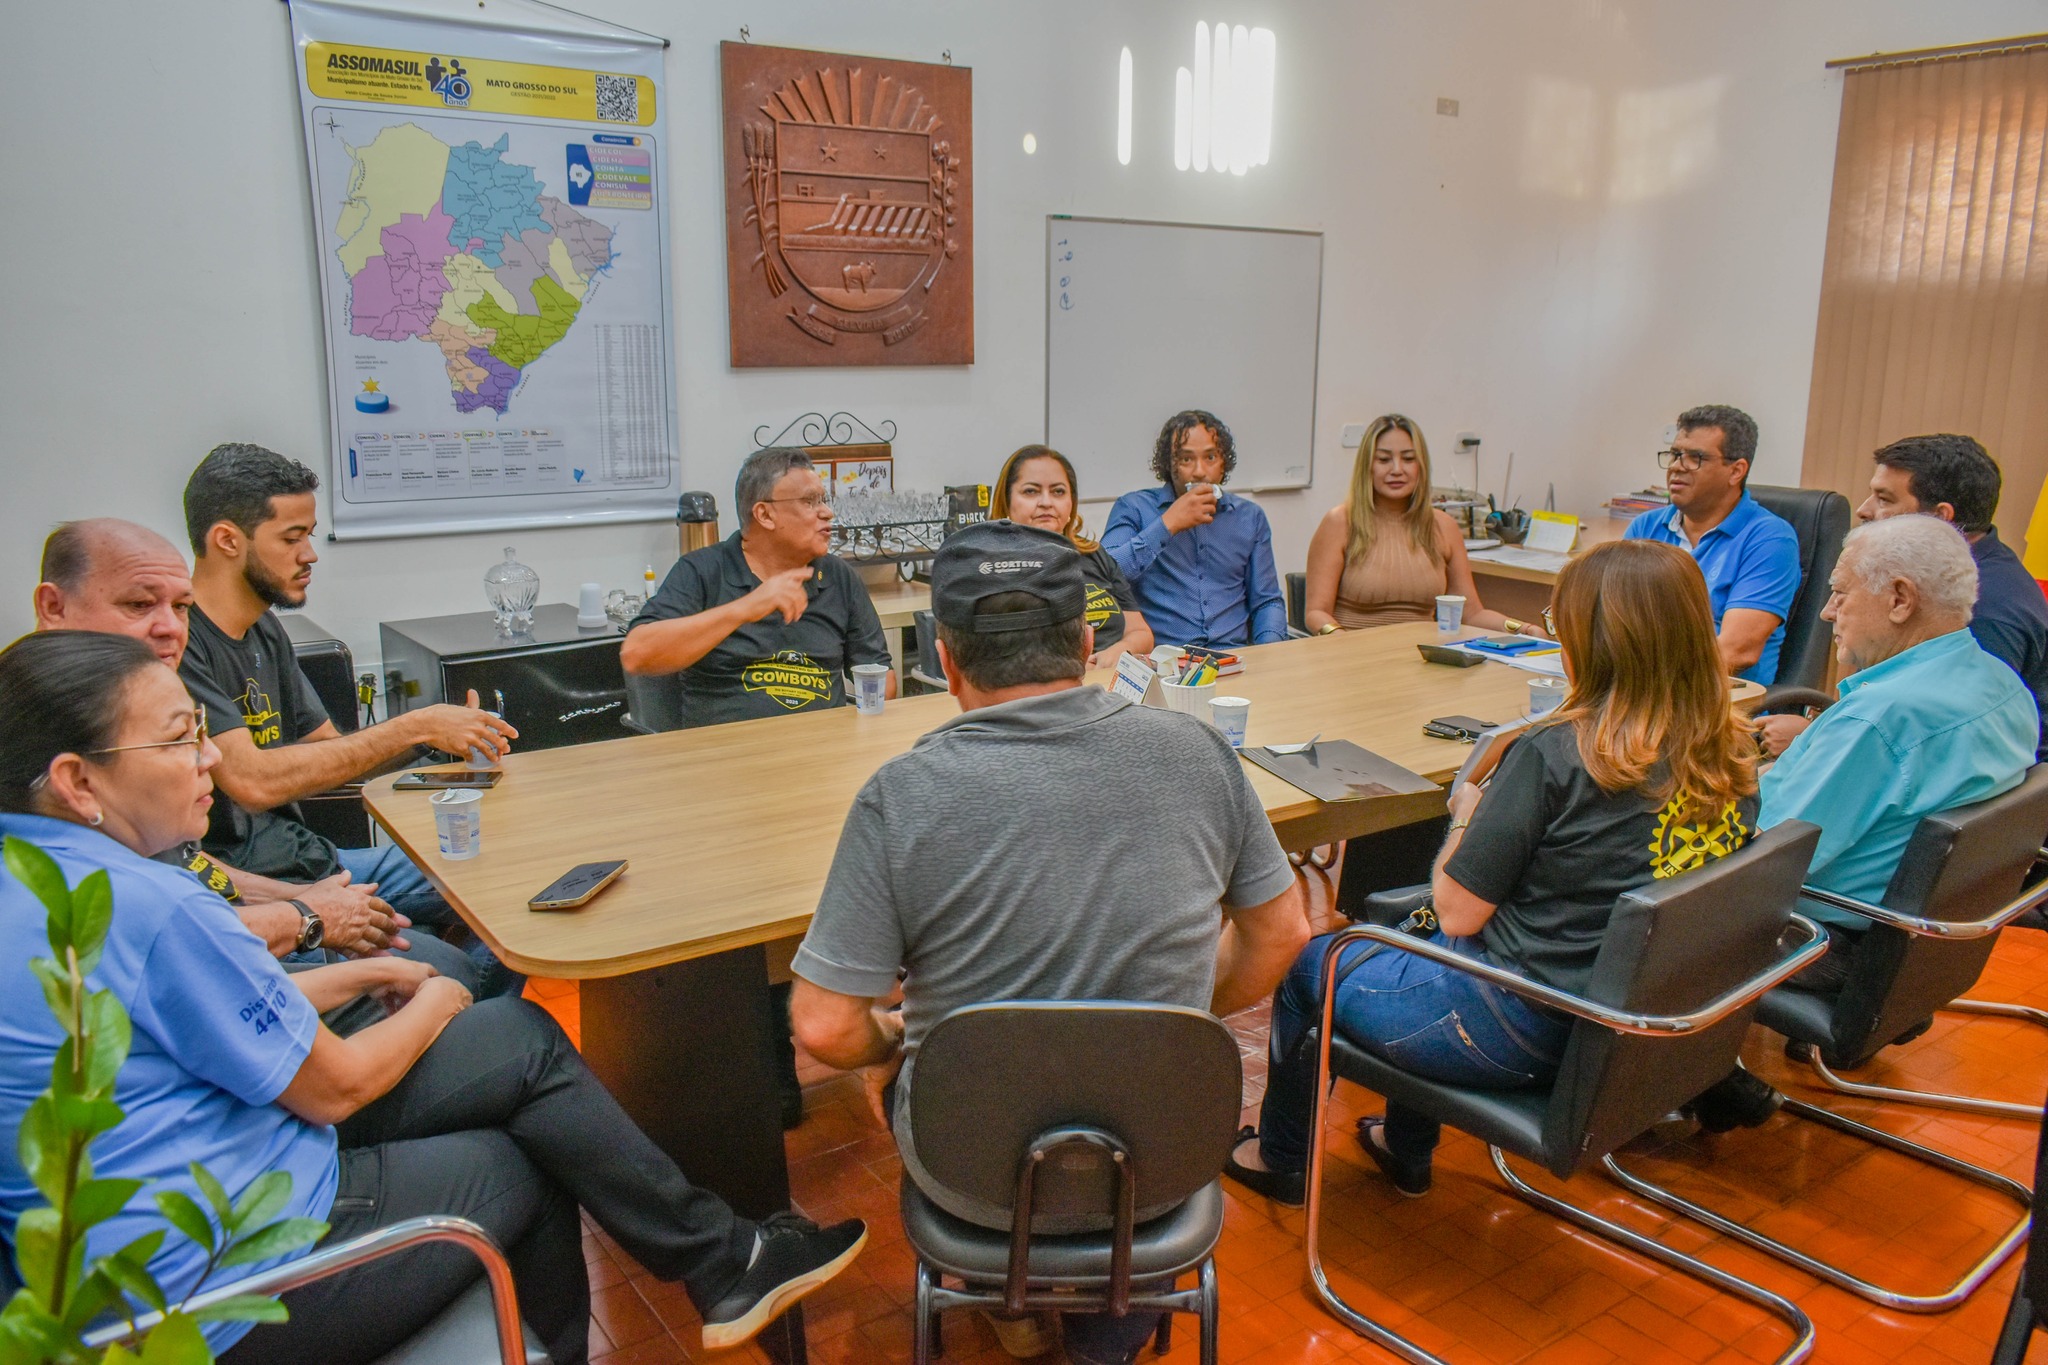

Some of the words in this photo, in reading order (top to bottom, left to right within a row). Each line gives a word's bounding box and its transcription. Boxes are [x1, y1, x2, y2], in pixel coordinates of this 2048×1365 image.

[327, 53, 422, 77] ASSOMASUL
[327, 76, 367, 87] Municipalismo
[486, 79, 511, 89] MATO
[512, 81, 547, 92] GROSSO
[548, 84, 561, 93] DO
[562, 86, 578, 95] SUL
[592, 156, 623, 164] CIDEMA
[597, 173, 638, 182] CODEVALE
[595, 182, 629, 190] CONISUL
[858, 462, 888, 480] Depois
[869, 475, 881, 490] de
[958, 511, 987, 525] BLACK
[994, 560, 1043, 569] CORTEVA
[751, 670, 827, 690] COWBOYS
